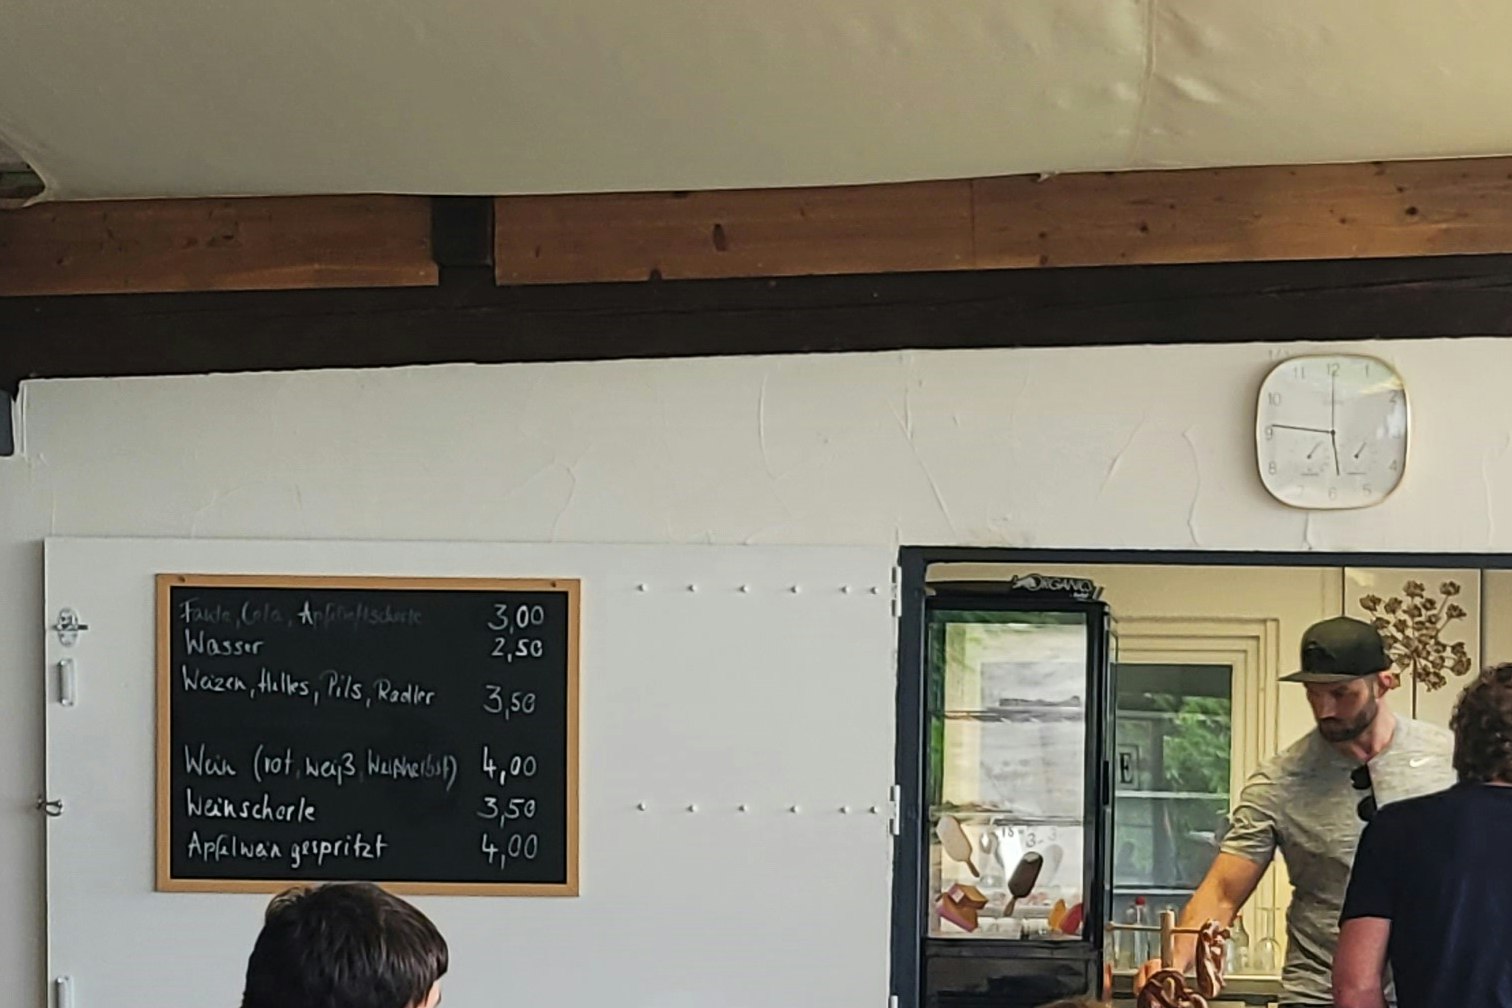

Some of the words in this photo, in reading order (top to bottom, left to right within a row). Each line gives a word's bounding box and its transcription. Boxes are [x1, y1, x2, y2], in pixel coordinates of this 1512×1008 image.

[1326, 363, 1341, 377] 12
[1268, 392, 1281, 406] 10
[487, 604, 545, 635] 3,00
[185, 628, 264, 655] Wasser
[490, 637, 544, 663] 2,50
[182, 665, 255, 698] Weizen,
[320, 669, 371, 708] Pils,
[376, 677, 436, 706] Radler
[483, 685, 536, 720] 3,50
[184, 743, 237, 777] Wein
[482, 745, 538, 786] 4,00
[186, 787, 316, 823] Weinschorle
[476, 796, 536, 828] 3,50
[187, 830, 282, 862] Apfelwein
[291, 833, 389, 869] gespritzt
[481, 834, 539, 868] 4,00
